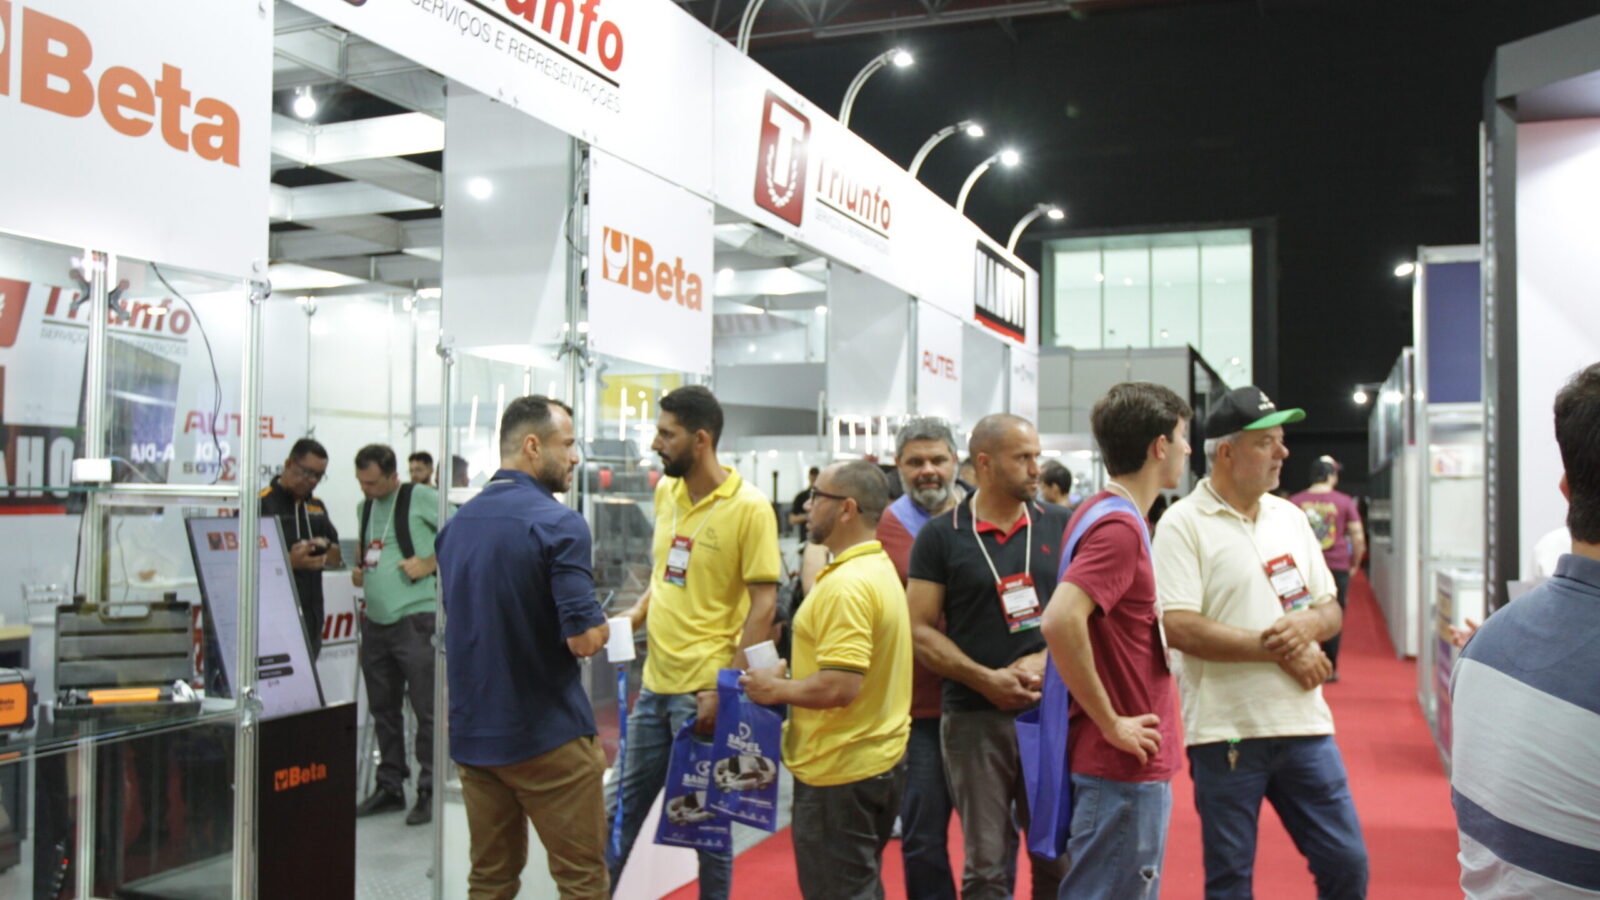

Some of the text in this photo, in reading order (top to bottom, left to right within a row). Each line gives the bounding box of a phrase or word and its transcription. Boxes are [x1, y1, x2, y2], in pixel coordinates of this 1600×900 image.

[410, 0, 491, 43] ERVIÇOS
[494, 30, 505, 50] E
[20, 6, 240, 168] Beta
[816, 156, 891, 231] Triunfo
[631, 236, 702, 311] Beta
[289, 762, 327, 788] Beta
